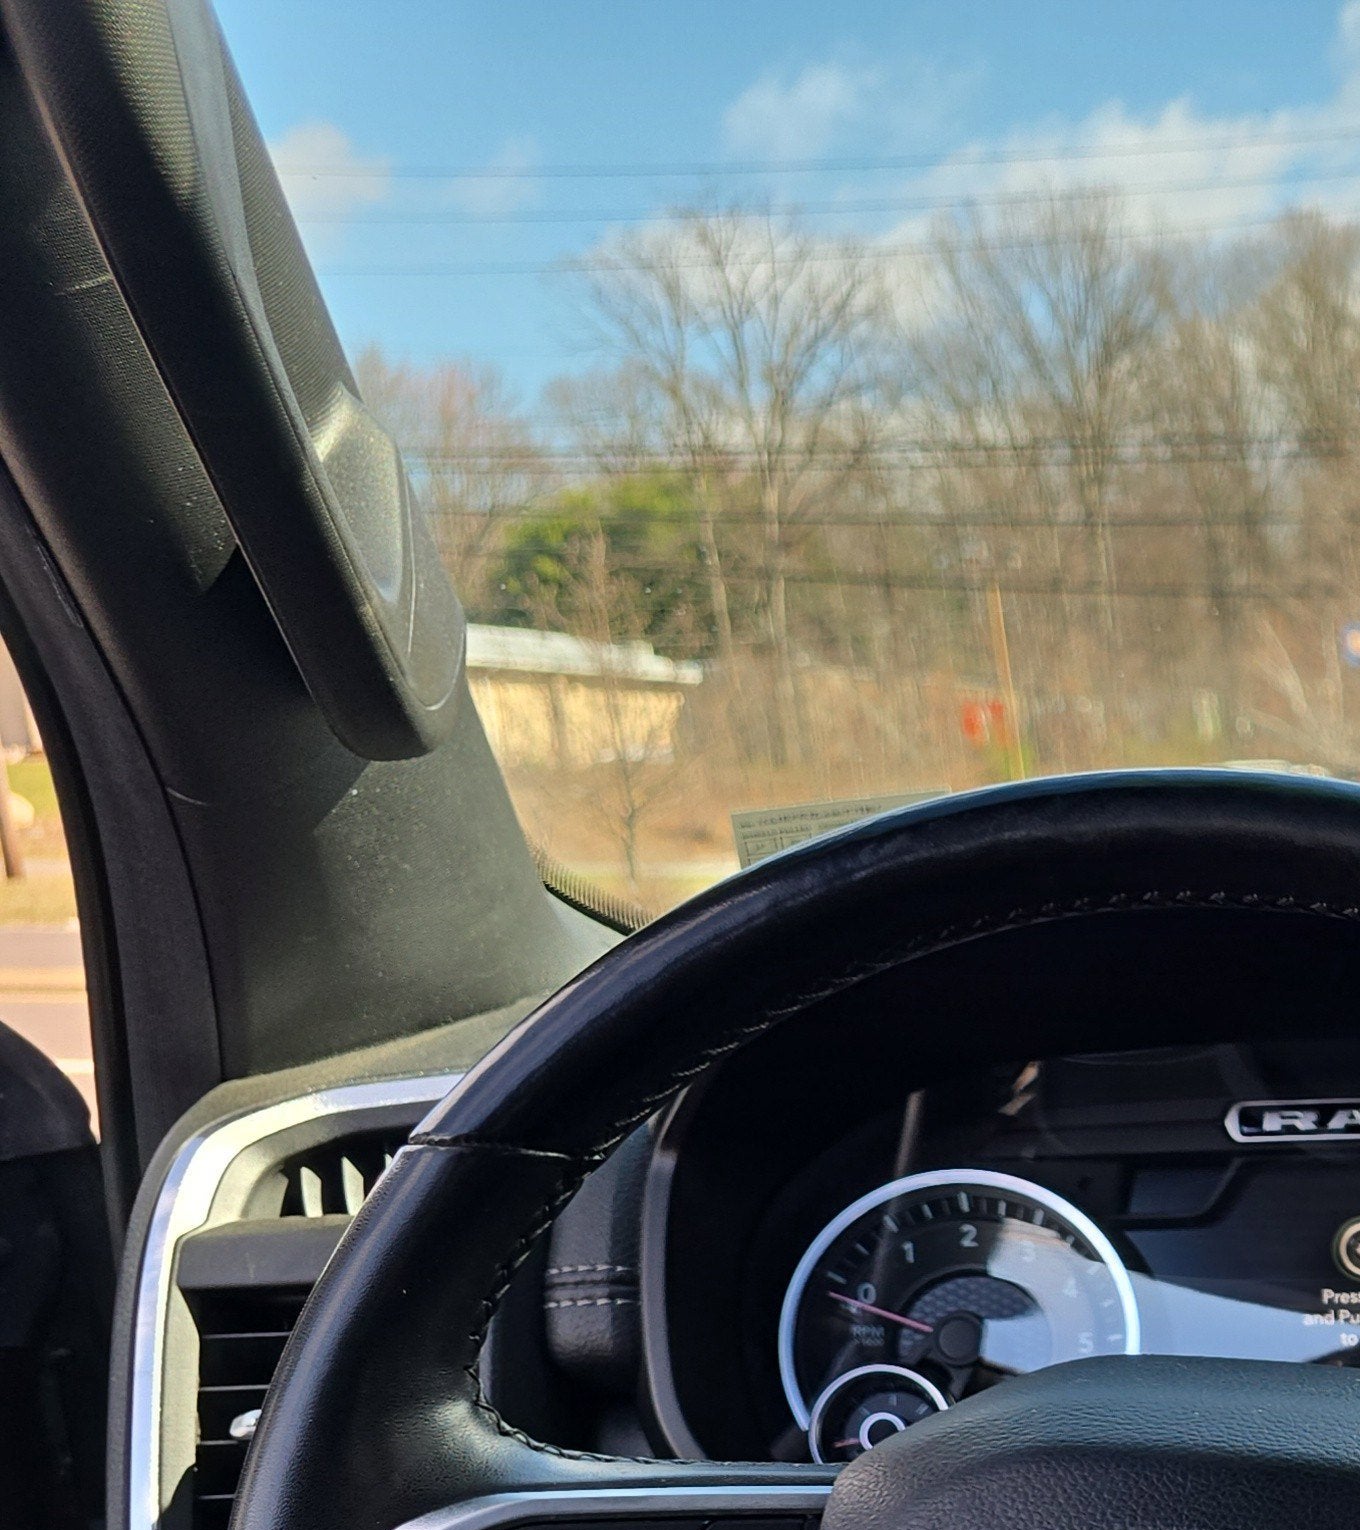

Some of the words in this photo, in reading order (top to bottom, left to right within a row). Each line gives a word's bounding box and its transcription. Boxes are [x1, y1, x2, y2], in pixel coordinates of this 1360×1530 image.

[960, 1223, 979, 1248] 2
[902, 1241, 914, 1263] 1
[857, 1282, 877, 1304] 0
[1303, 1310, 1335, 1326] and
[1340, 1332, 1359, 1346] to
